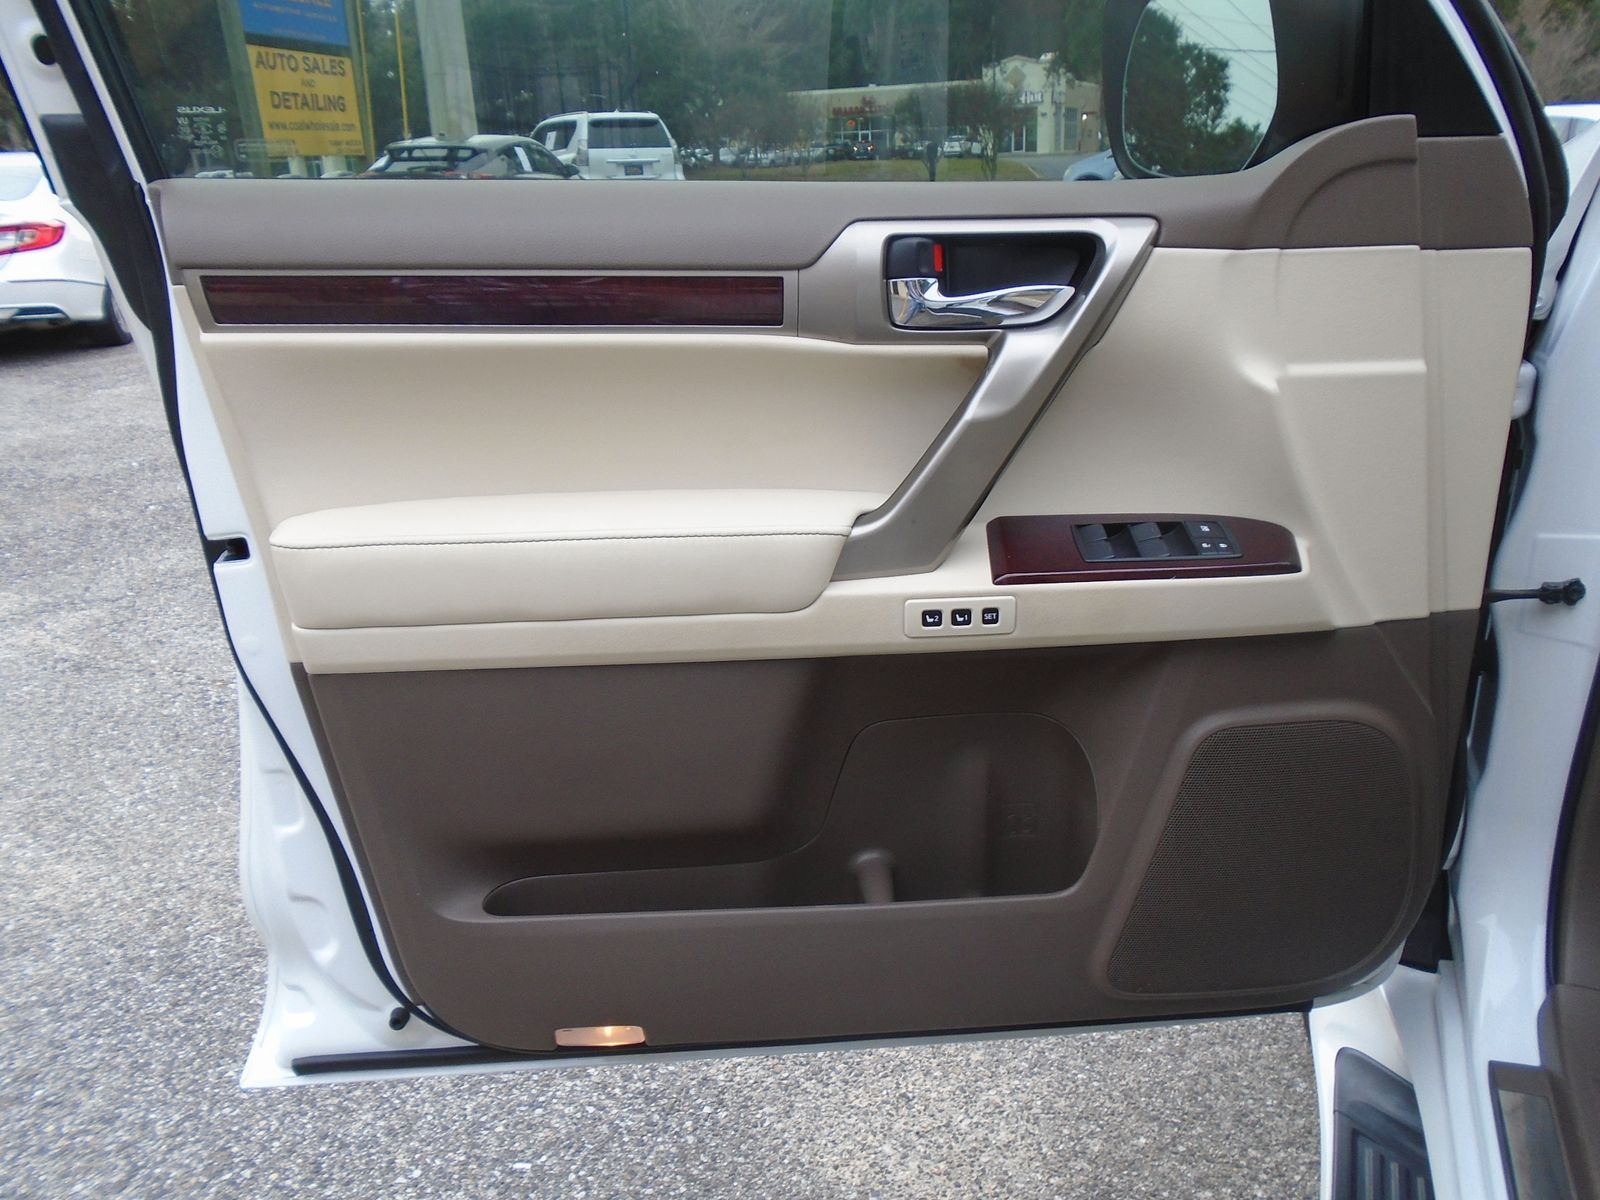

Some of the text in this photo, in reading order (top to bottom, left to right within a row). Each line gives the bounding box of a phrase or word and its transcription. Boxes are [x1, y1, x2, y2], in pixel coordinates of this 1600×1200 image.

[255, 51, 346, 77] AUTO SALES
[301, 78, 315, 88] AND
[269, 90, 346, 113] DETAILING
[984, 612, 997, 620] SET
